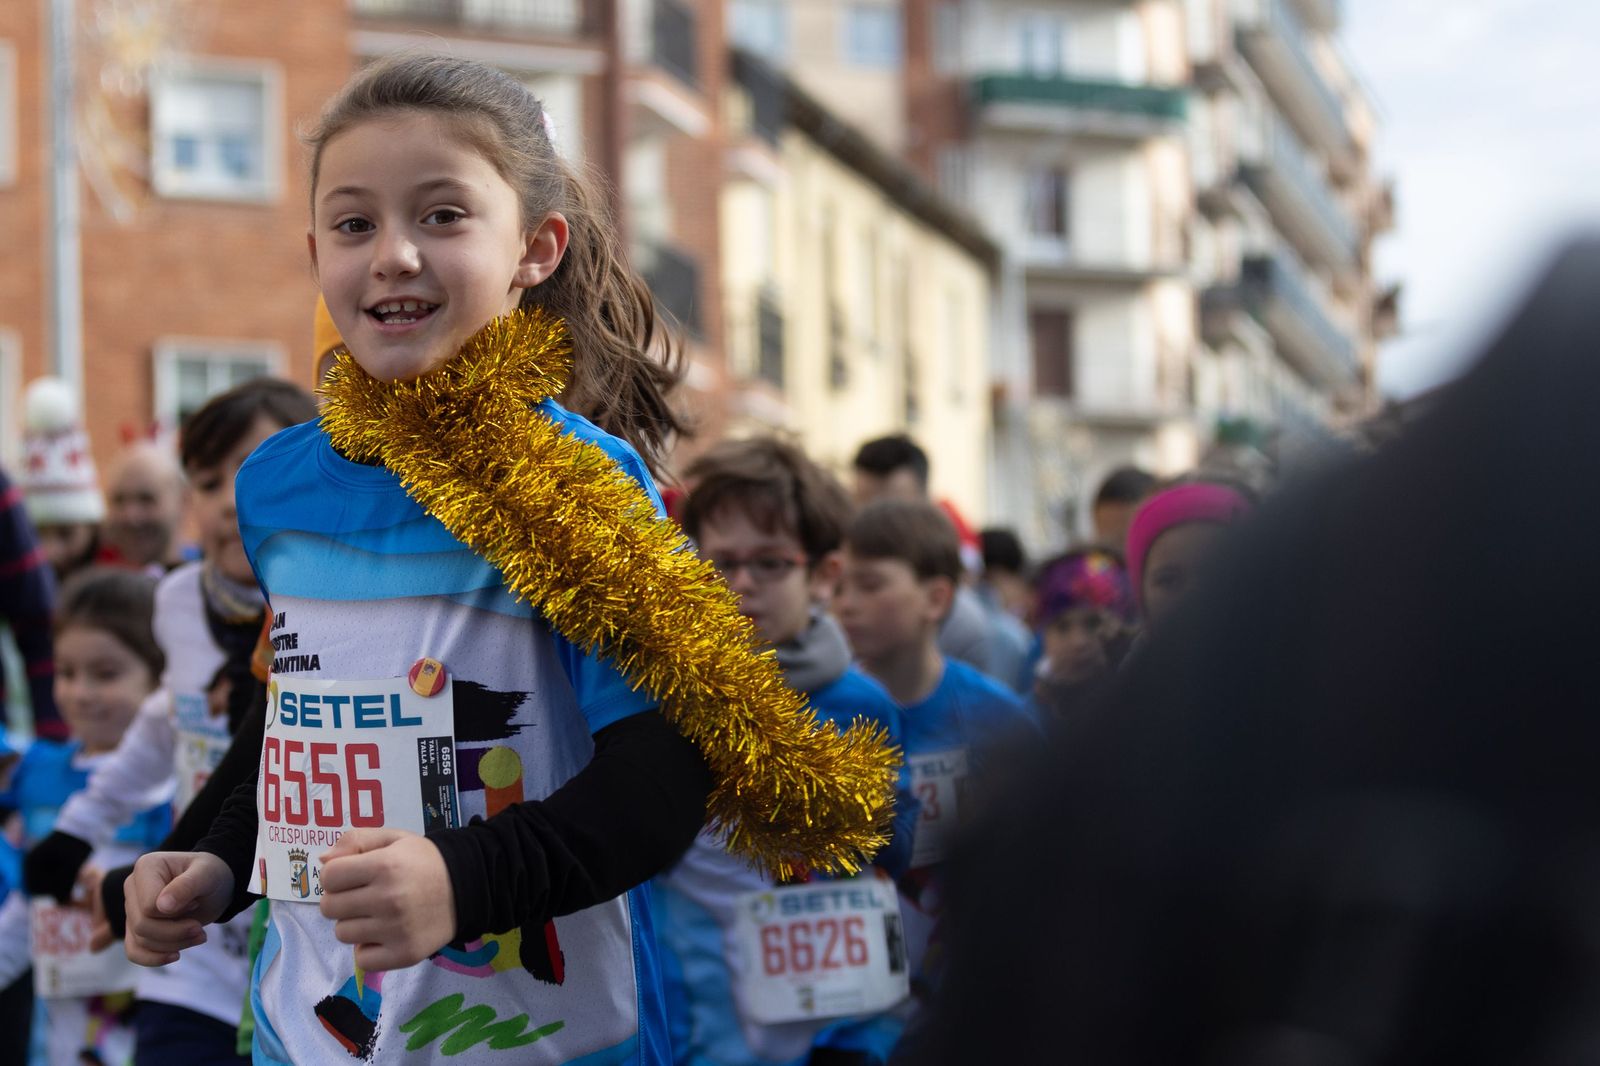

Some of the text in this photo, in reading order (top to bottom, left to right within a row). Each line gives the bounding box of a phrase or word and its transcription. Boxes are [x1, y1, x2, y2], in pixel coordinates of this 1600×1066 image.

[280, 691, 422, 728] SETEL
[420, 740, 428, 764] TALLA
[441, 746, 451, 775] 6556
[264, 737, 385, 828] 6556
[916, 783, 942, 821] 3
[314, 884, 325, 896] de
[779, 888, 884, 916] SETEL
[760, 916, 869, 977] 6626
